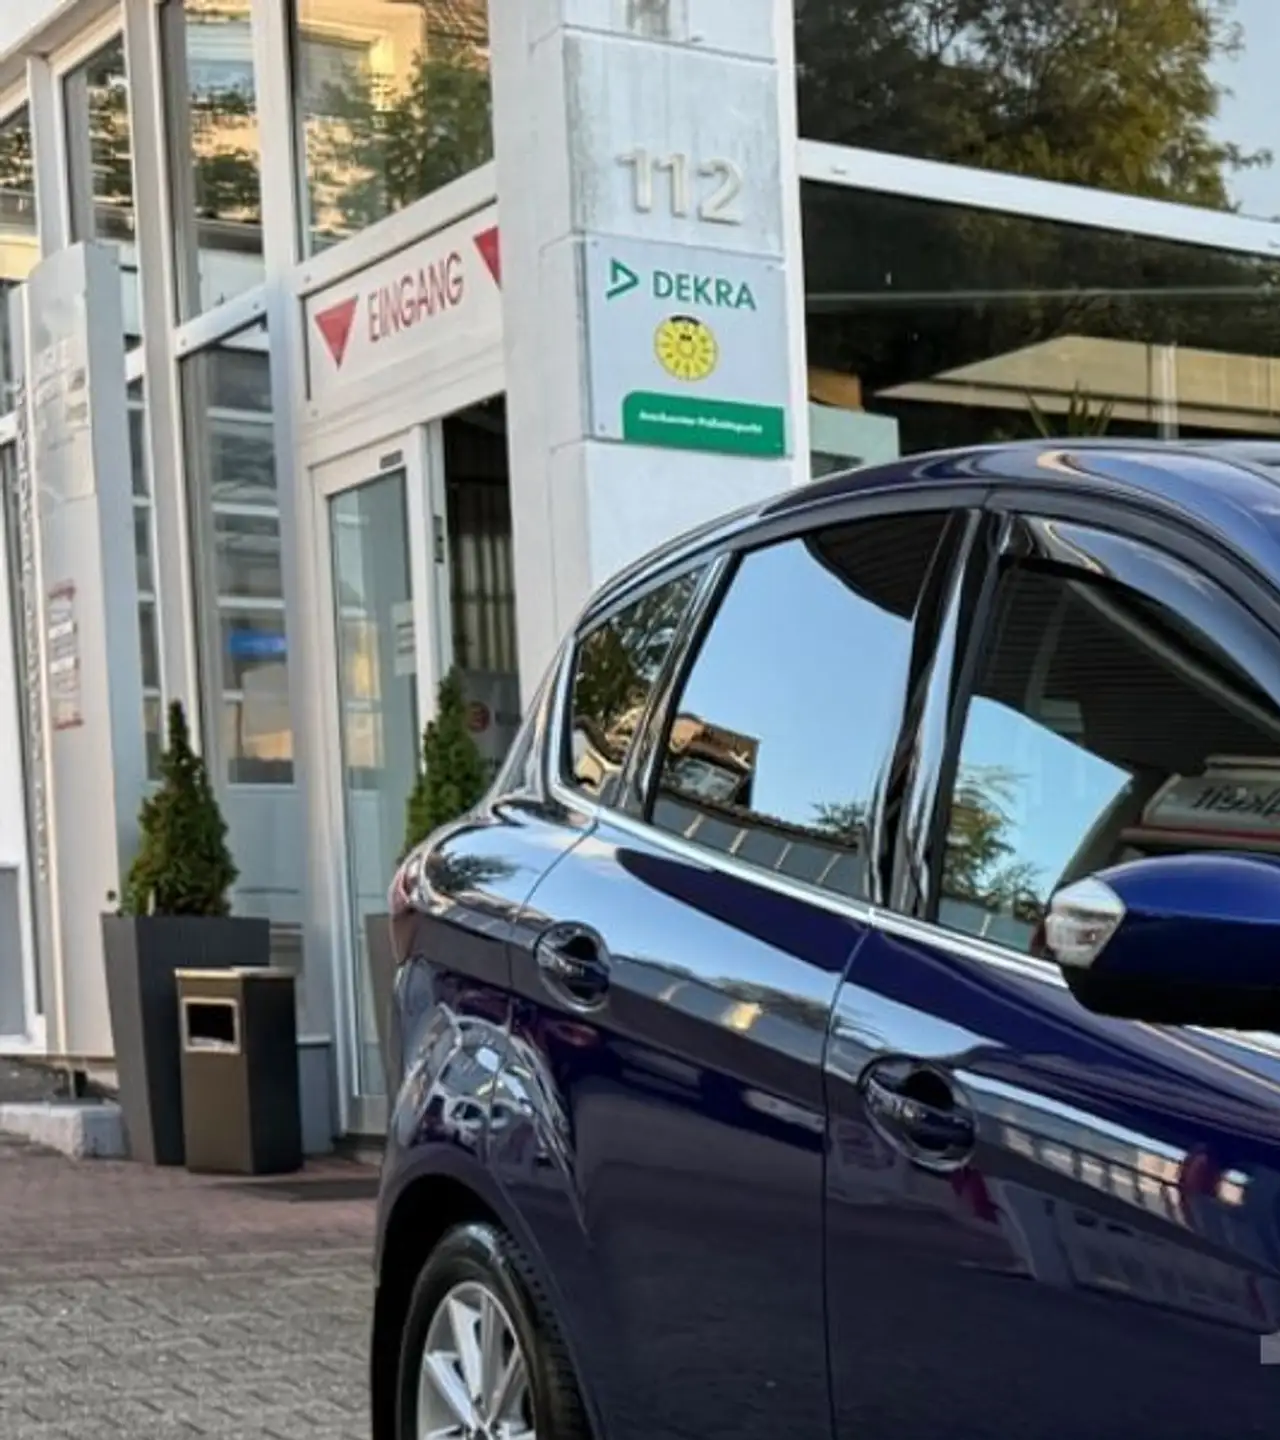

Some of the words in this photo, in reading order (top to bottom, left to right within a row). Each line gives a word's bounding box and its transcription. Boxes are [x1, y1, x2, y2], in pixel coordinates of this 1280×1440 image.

[616, 147, 743, 226] 112
[367, 251, 464, 343] EINGANG
[653, 270, 757, 311] DEKRA
